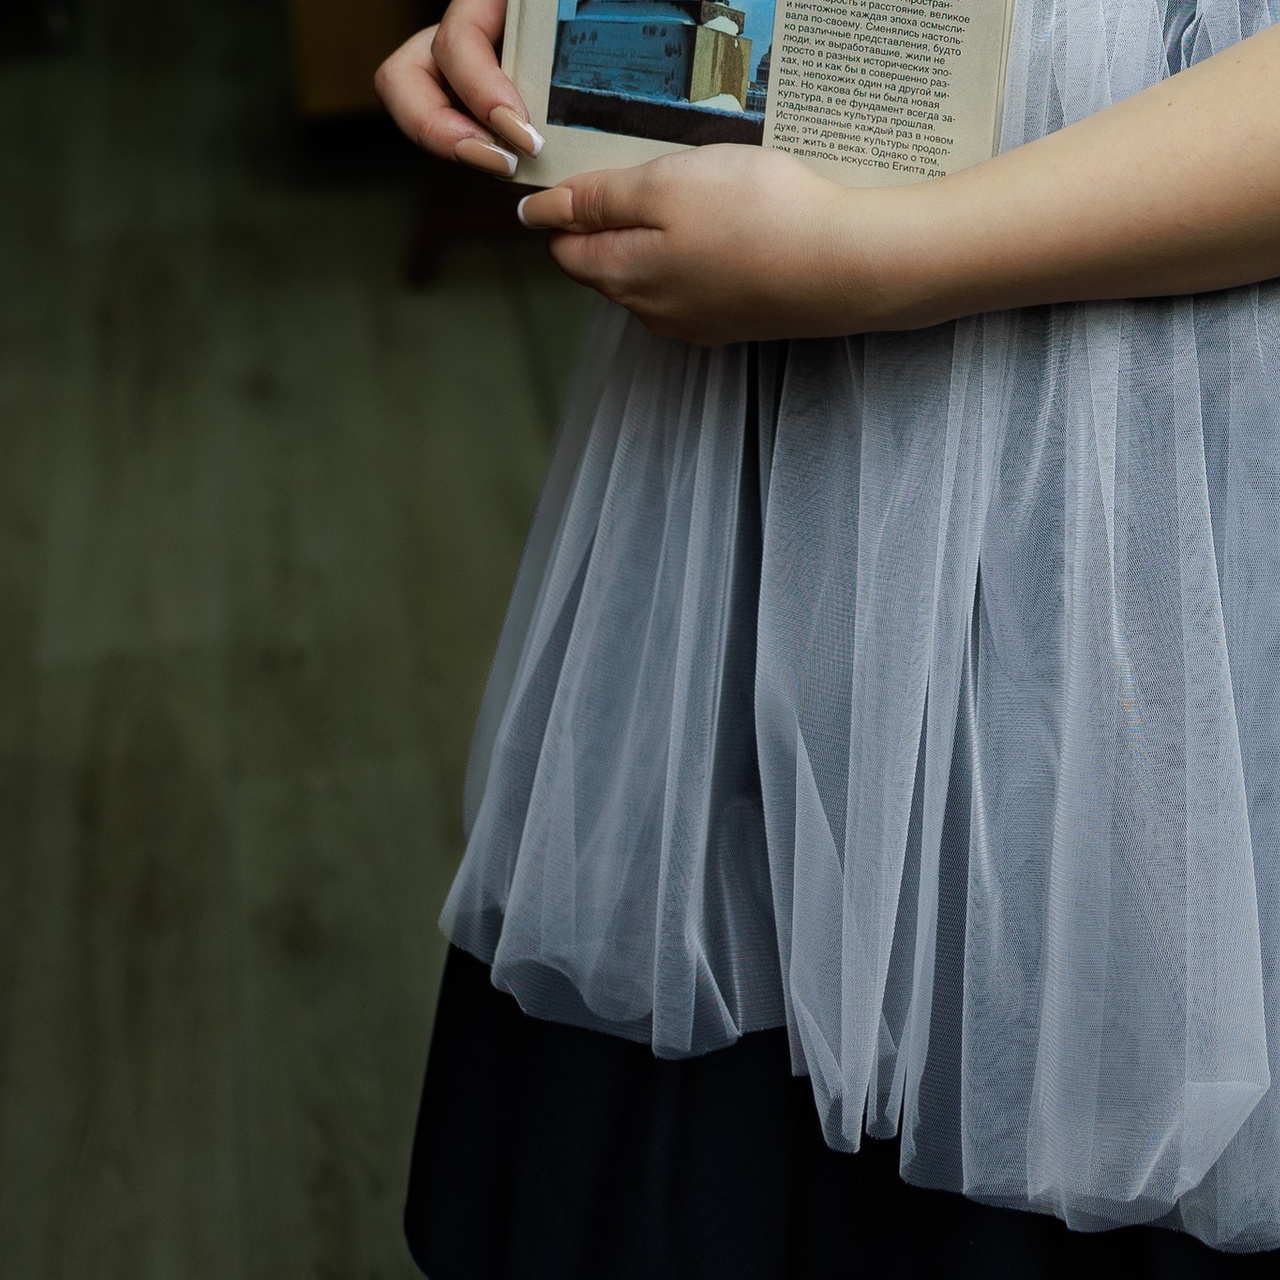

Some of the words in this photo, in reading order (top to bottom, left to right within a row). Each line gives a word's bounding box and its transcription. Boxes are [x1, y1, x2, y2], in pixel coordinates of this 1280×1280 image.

[786, 0, 792, 8] и
[794, 1, 847, 16] ничтожное
[850, 10, 887, 22] каждая
[889, 15, 917, 26] эпоха
[919, 20, 965, 33] осмысли-
[929, 10, 970, 24] великое
